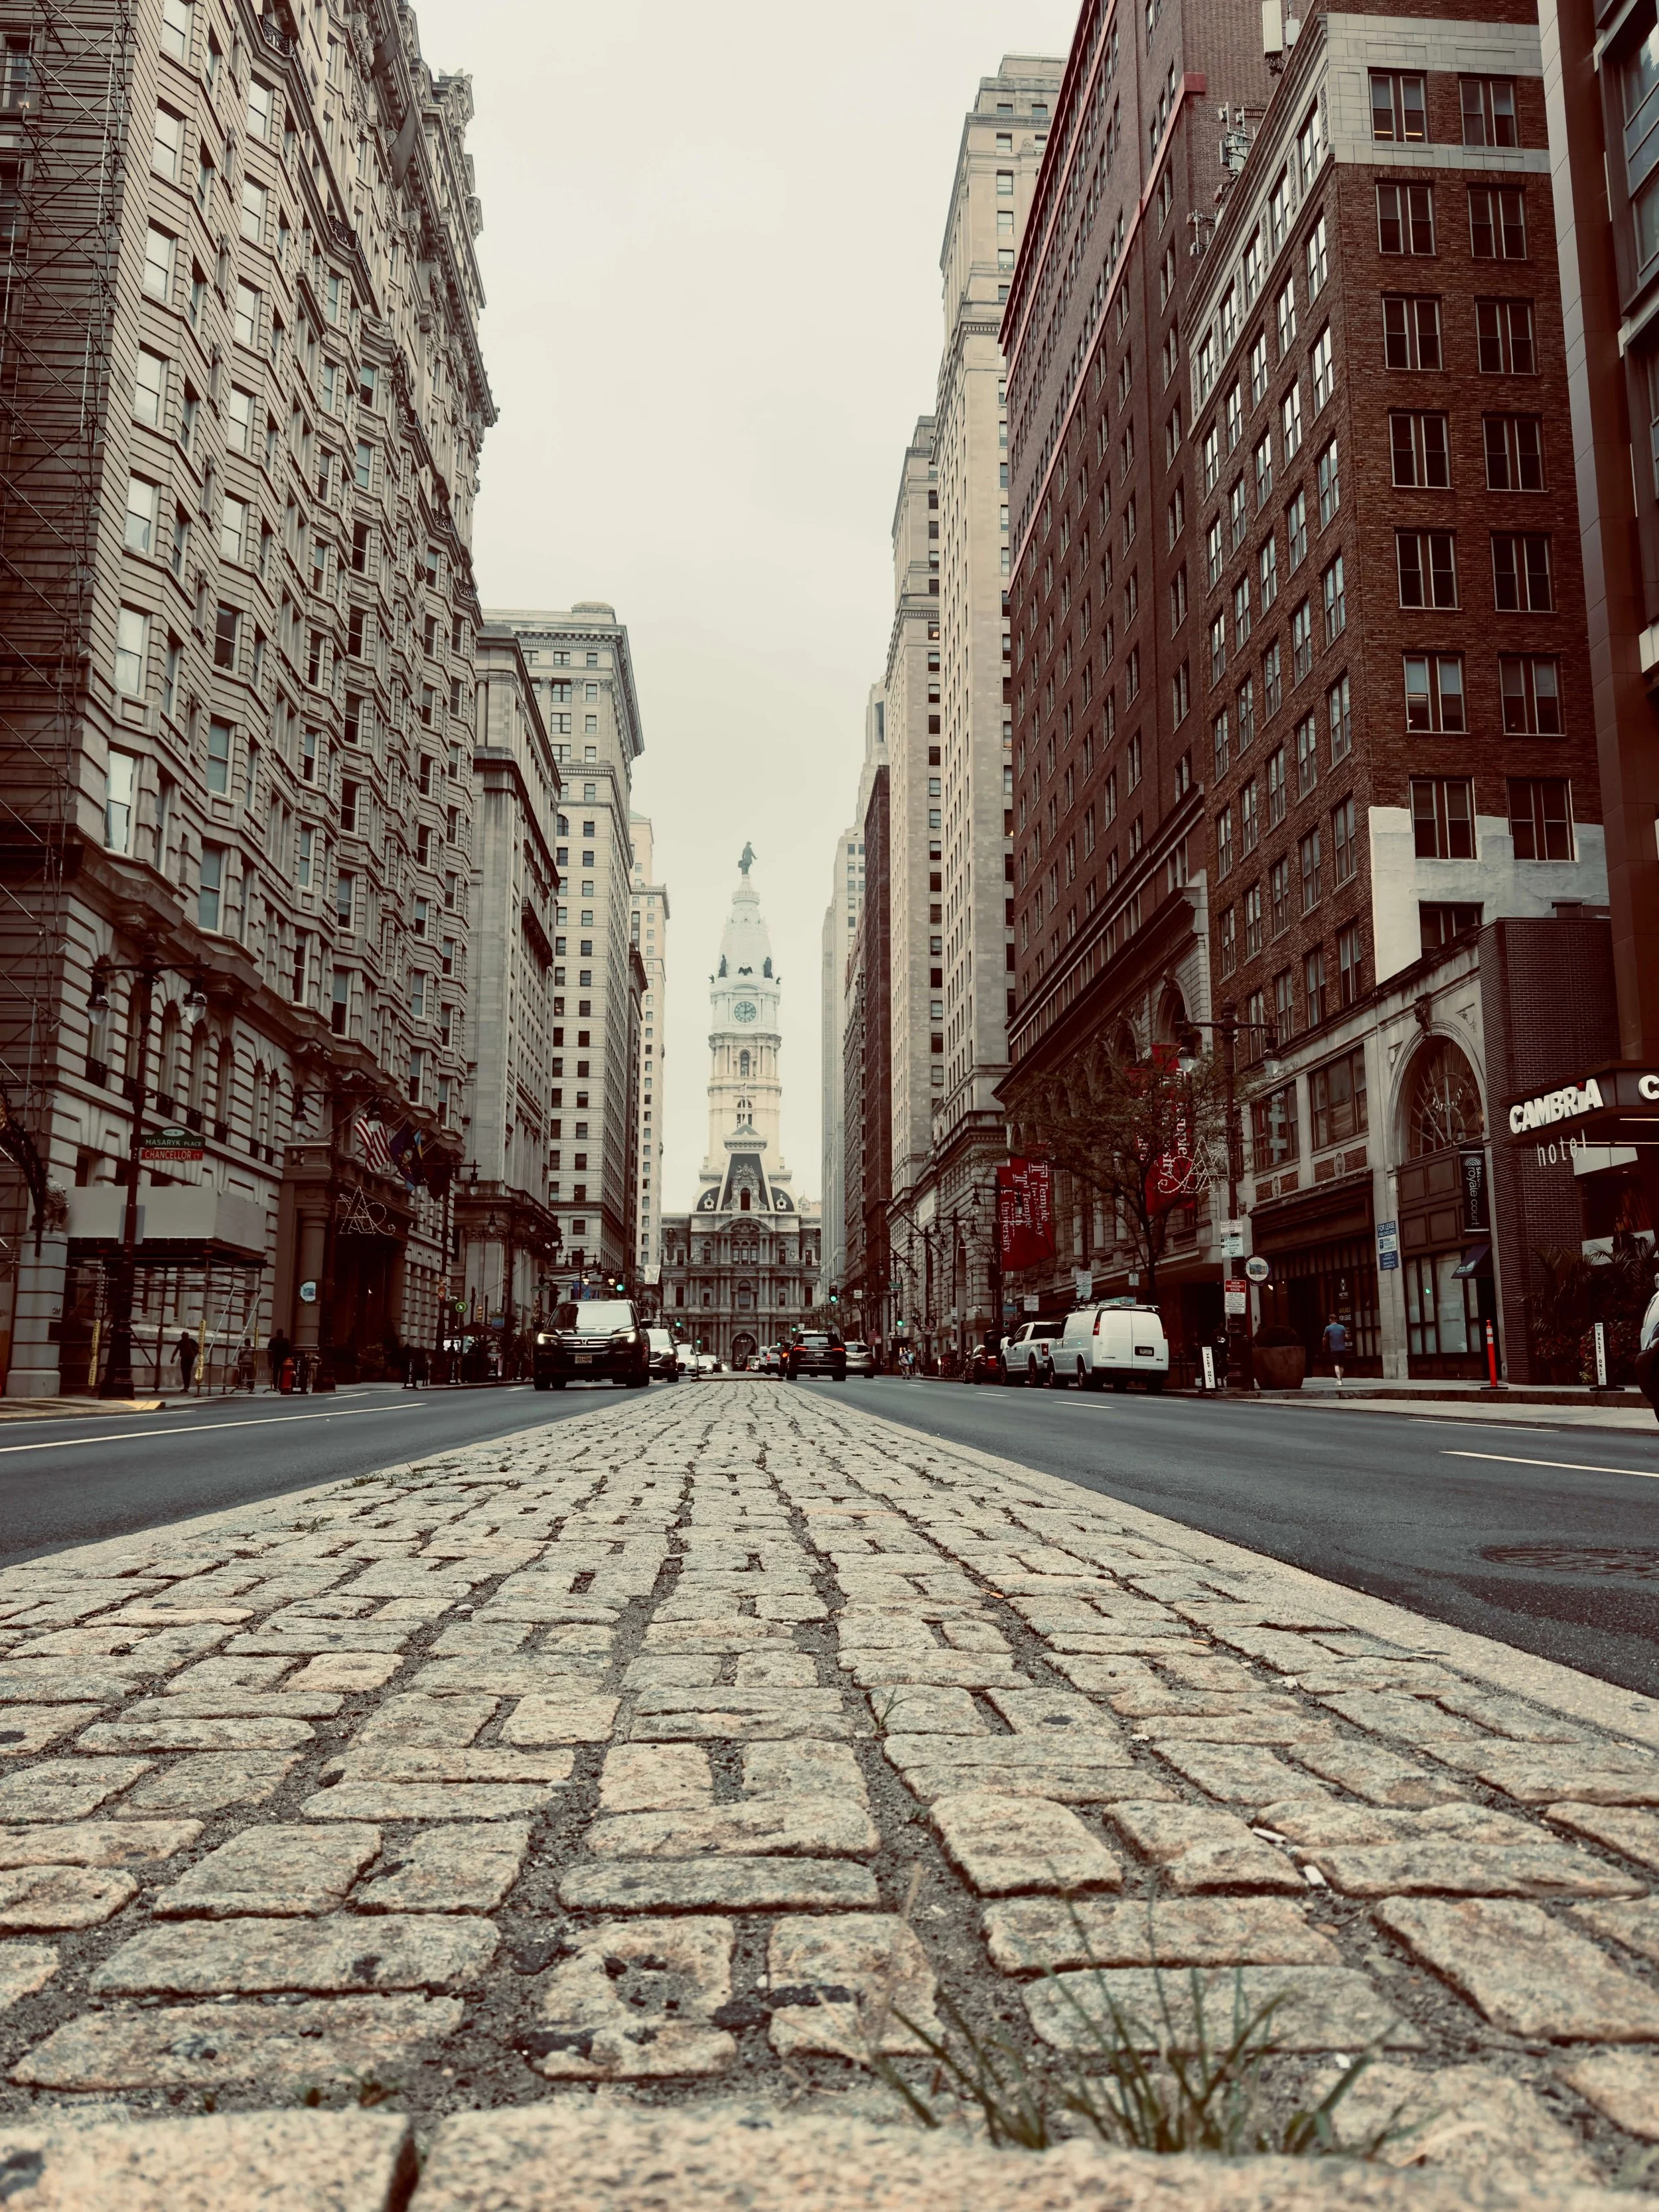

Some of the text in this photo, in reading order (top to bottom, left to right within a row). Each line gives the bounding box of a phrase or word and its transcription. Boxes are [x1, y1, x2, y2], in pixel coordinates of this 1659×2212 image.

[145, 1150, 191, 1159] CHANCELLOR
[1537, 1129, 1587, 1167] hotel
[1023, 1192, 1033, 1228] Temple
[1030, 1182, 1045, 1237] Unrity
[1039, 1182, 1049, 1221] Temple
[1466, 1167, 1480, 1226] royale court
[1001, 1201, 1011, 1253] University
[1385, 1221, 1395, 1230] LEASE
